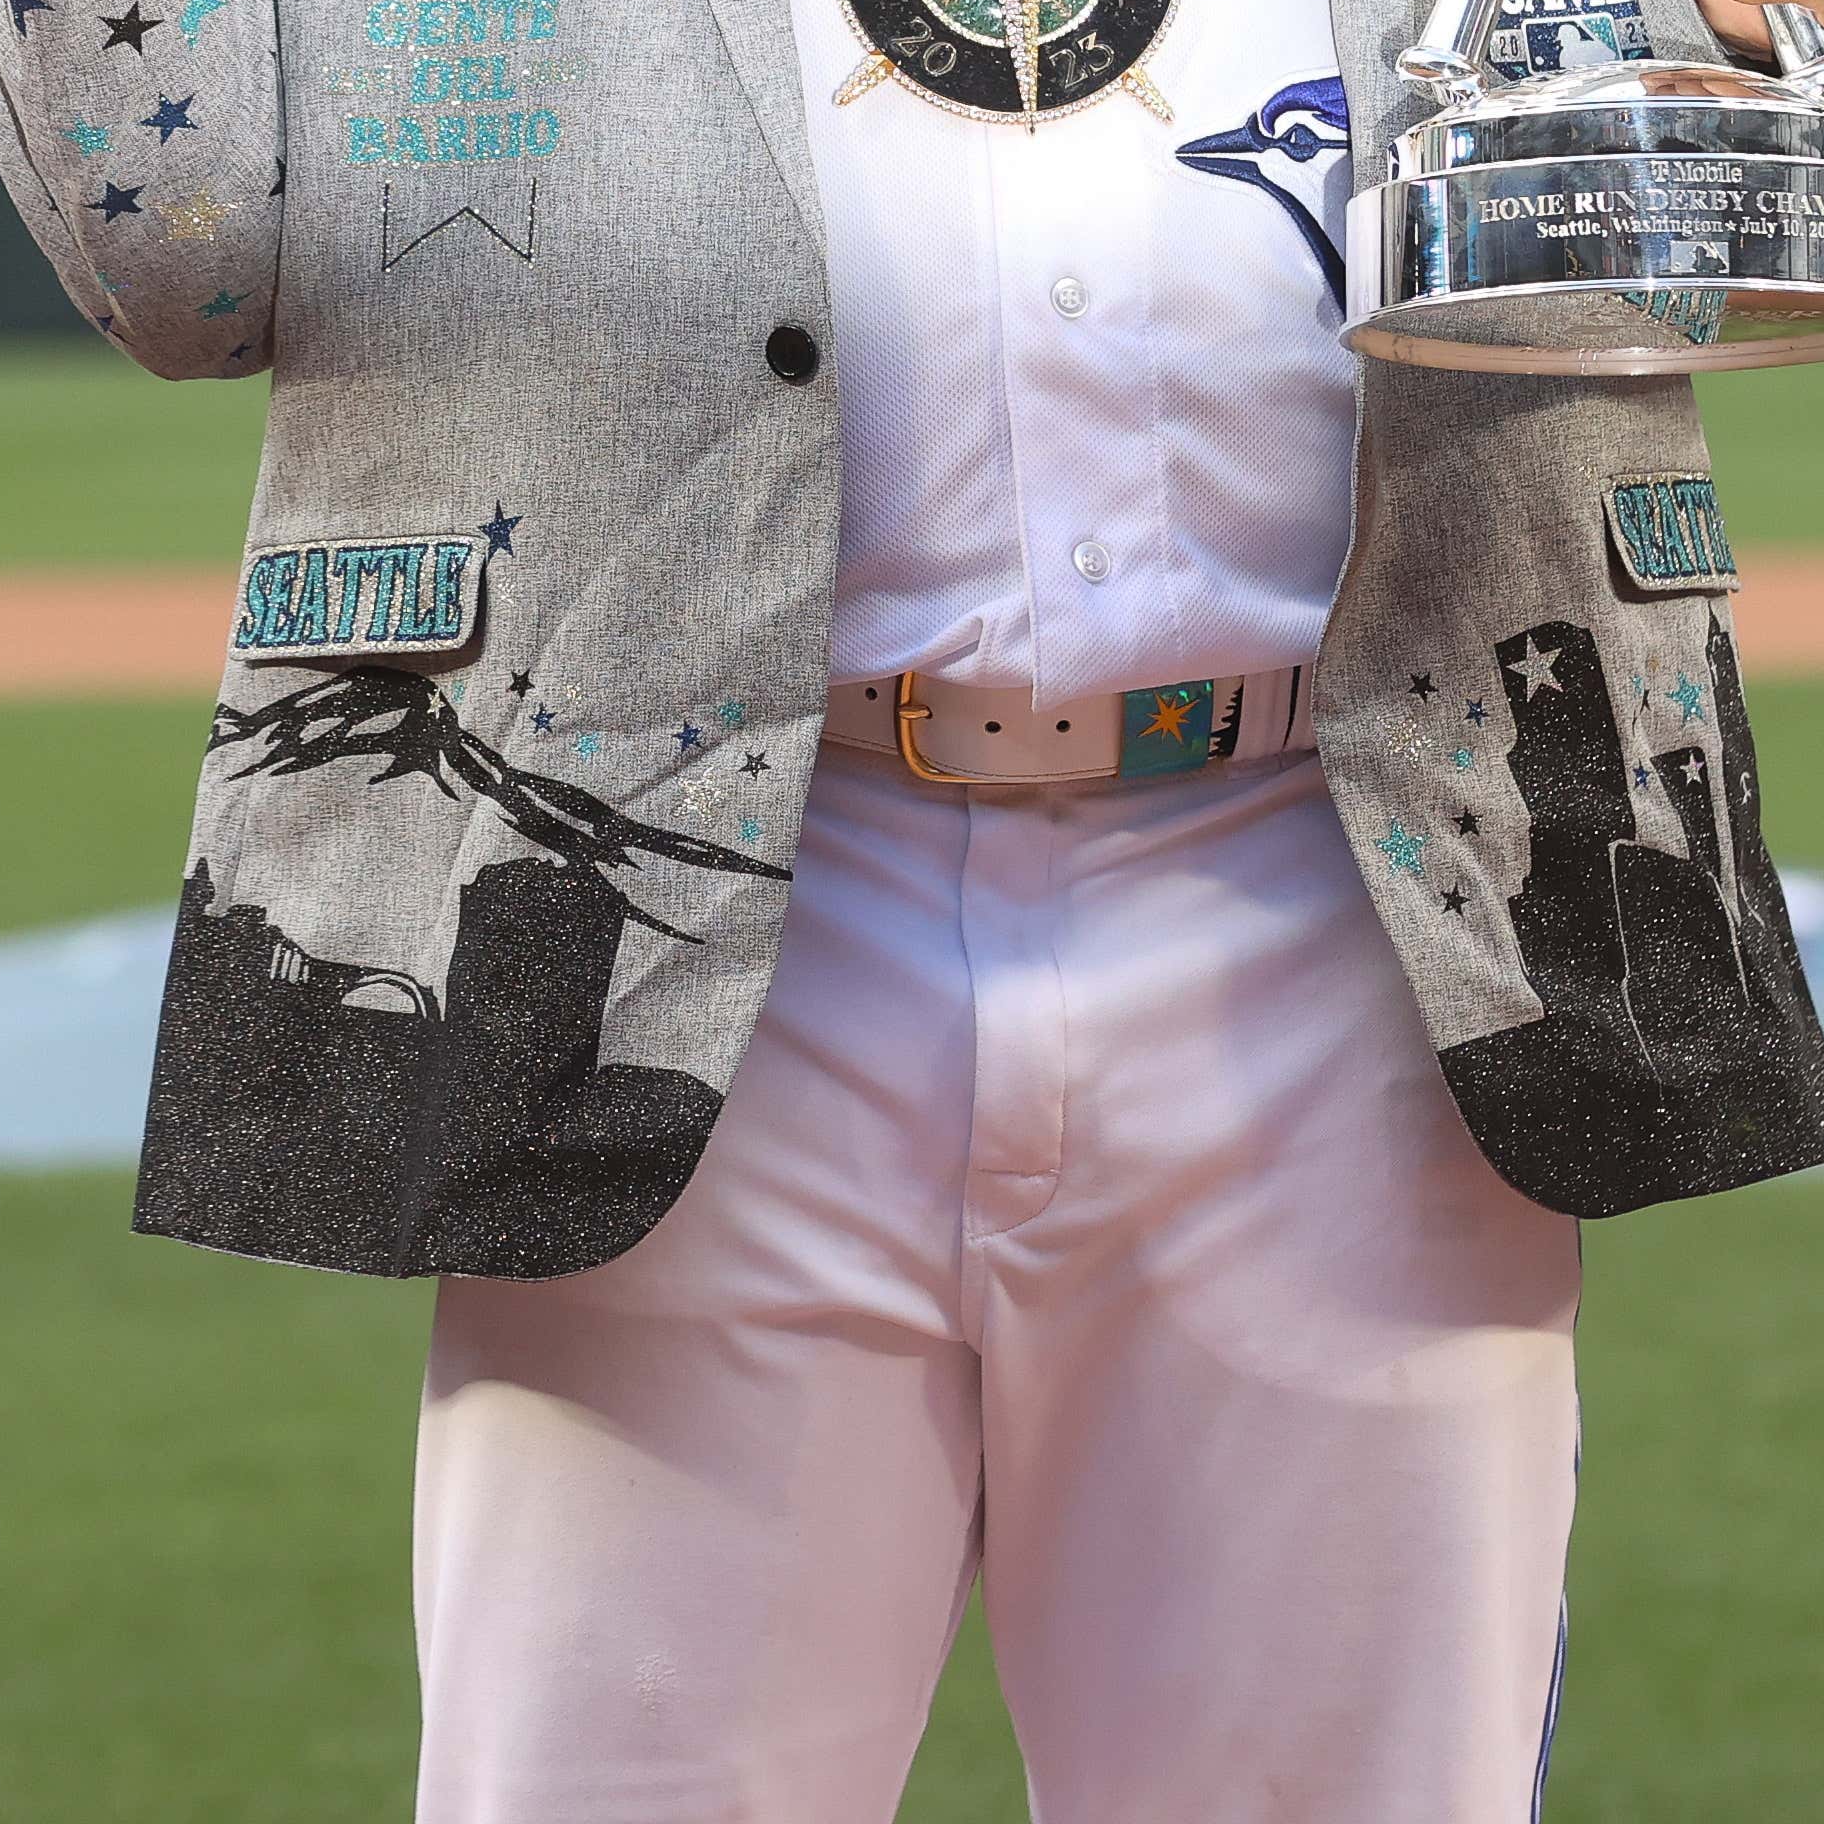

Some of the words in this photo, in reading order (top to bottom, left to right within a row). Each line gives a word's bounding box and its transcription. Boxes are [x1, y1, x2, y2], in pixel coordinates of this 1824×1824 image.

[409, 54, 517, 105] DEL
[888, 15, 958, 77] 20
[1049, 30, 1115, 90] 23
[342, 108, 563, 166] BARRIO
[1478, 193, 1565, 224] HOME
[1574, 189, 1638, 214] RUN
[1645, 188, 1749, 213] DERBY
[1536, 218, 1608, 239] Seattle,
[234, 540, 473, 649] SEATTLE
